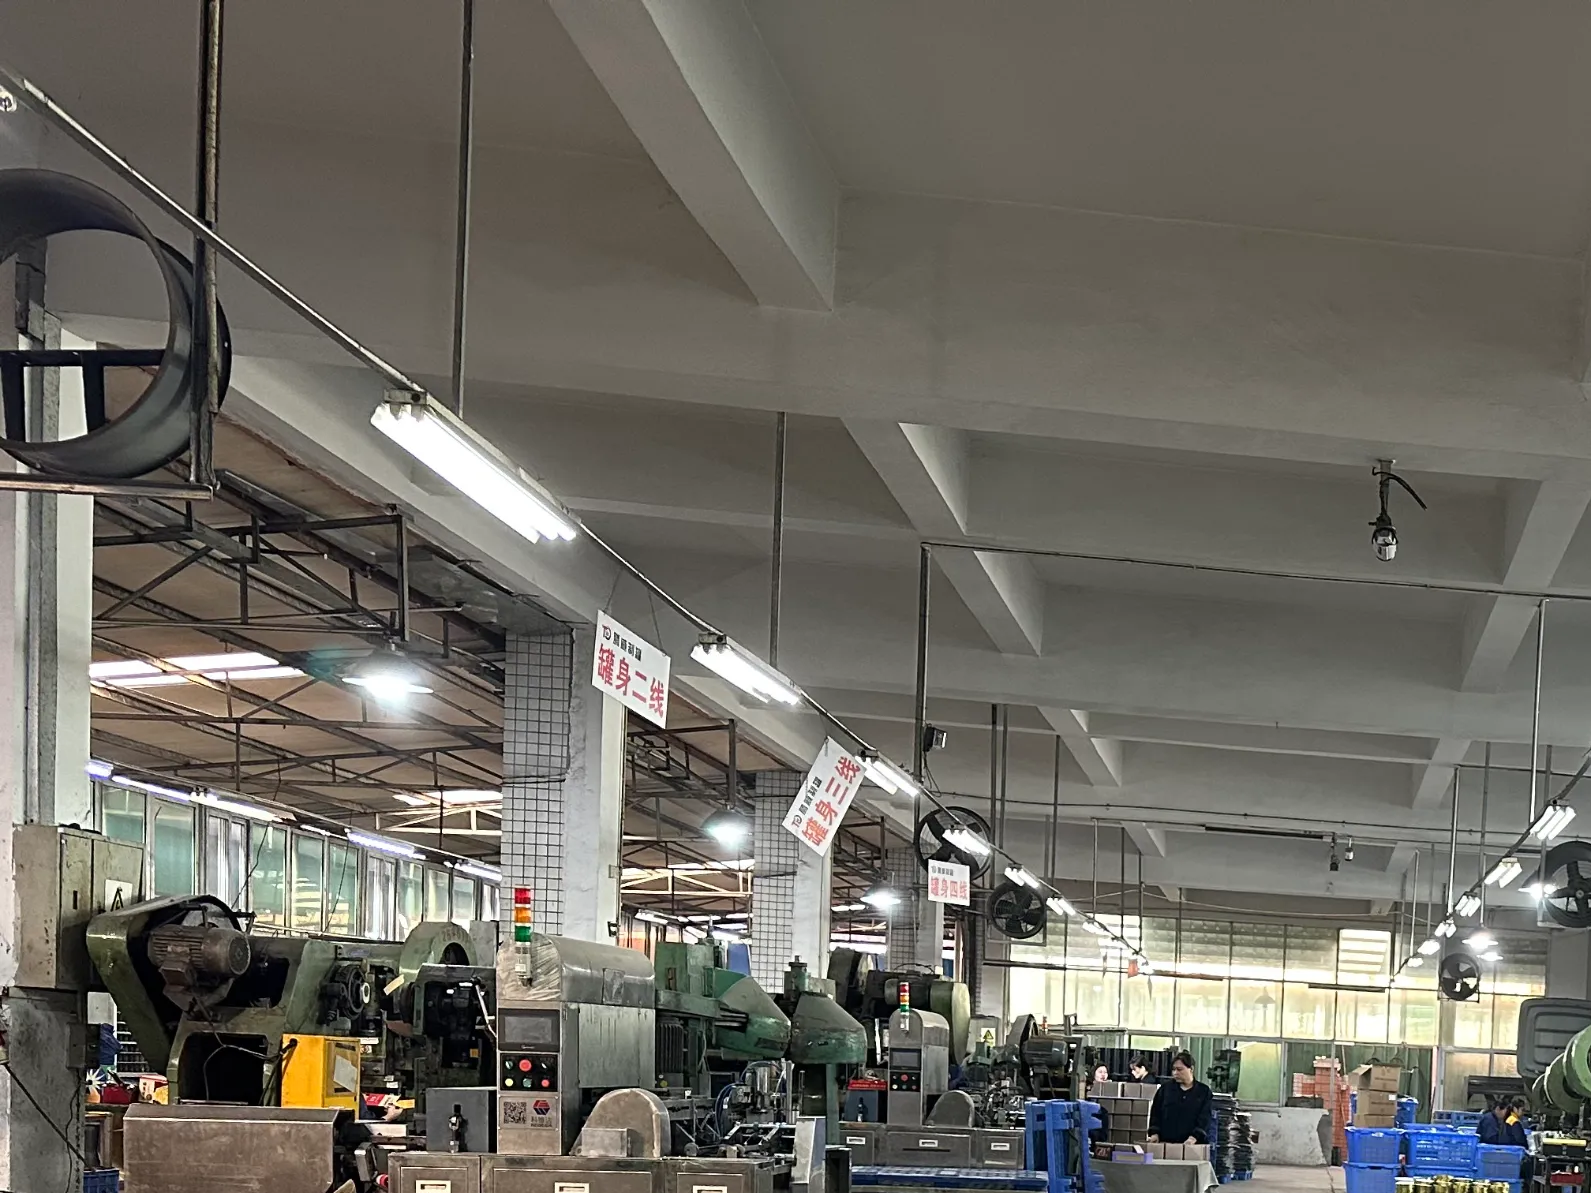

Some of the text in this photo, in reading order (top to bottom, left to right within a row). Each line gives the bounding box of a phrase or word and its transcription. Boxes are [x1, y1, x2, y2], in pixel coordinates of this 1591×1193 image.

[597, 642, 665, 719] 罐身二线
[801, 756, 861, 847] 罐身三线
